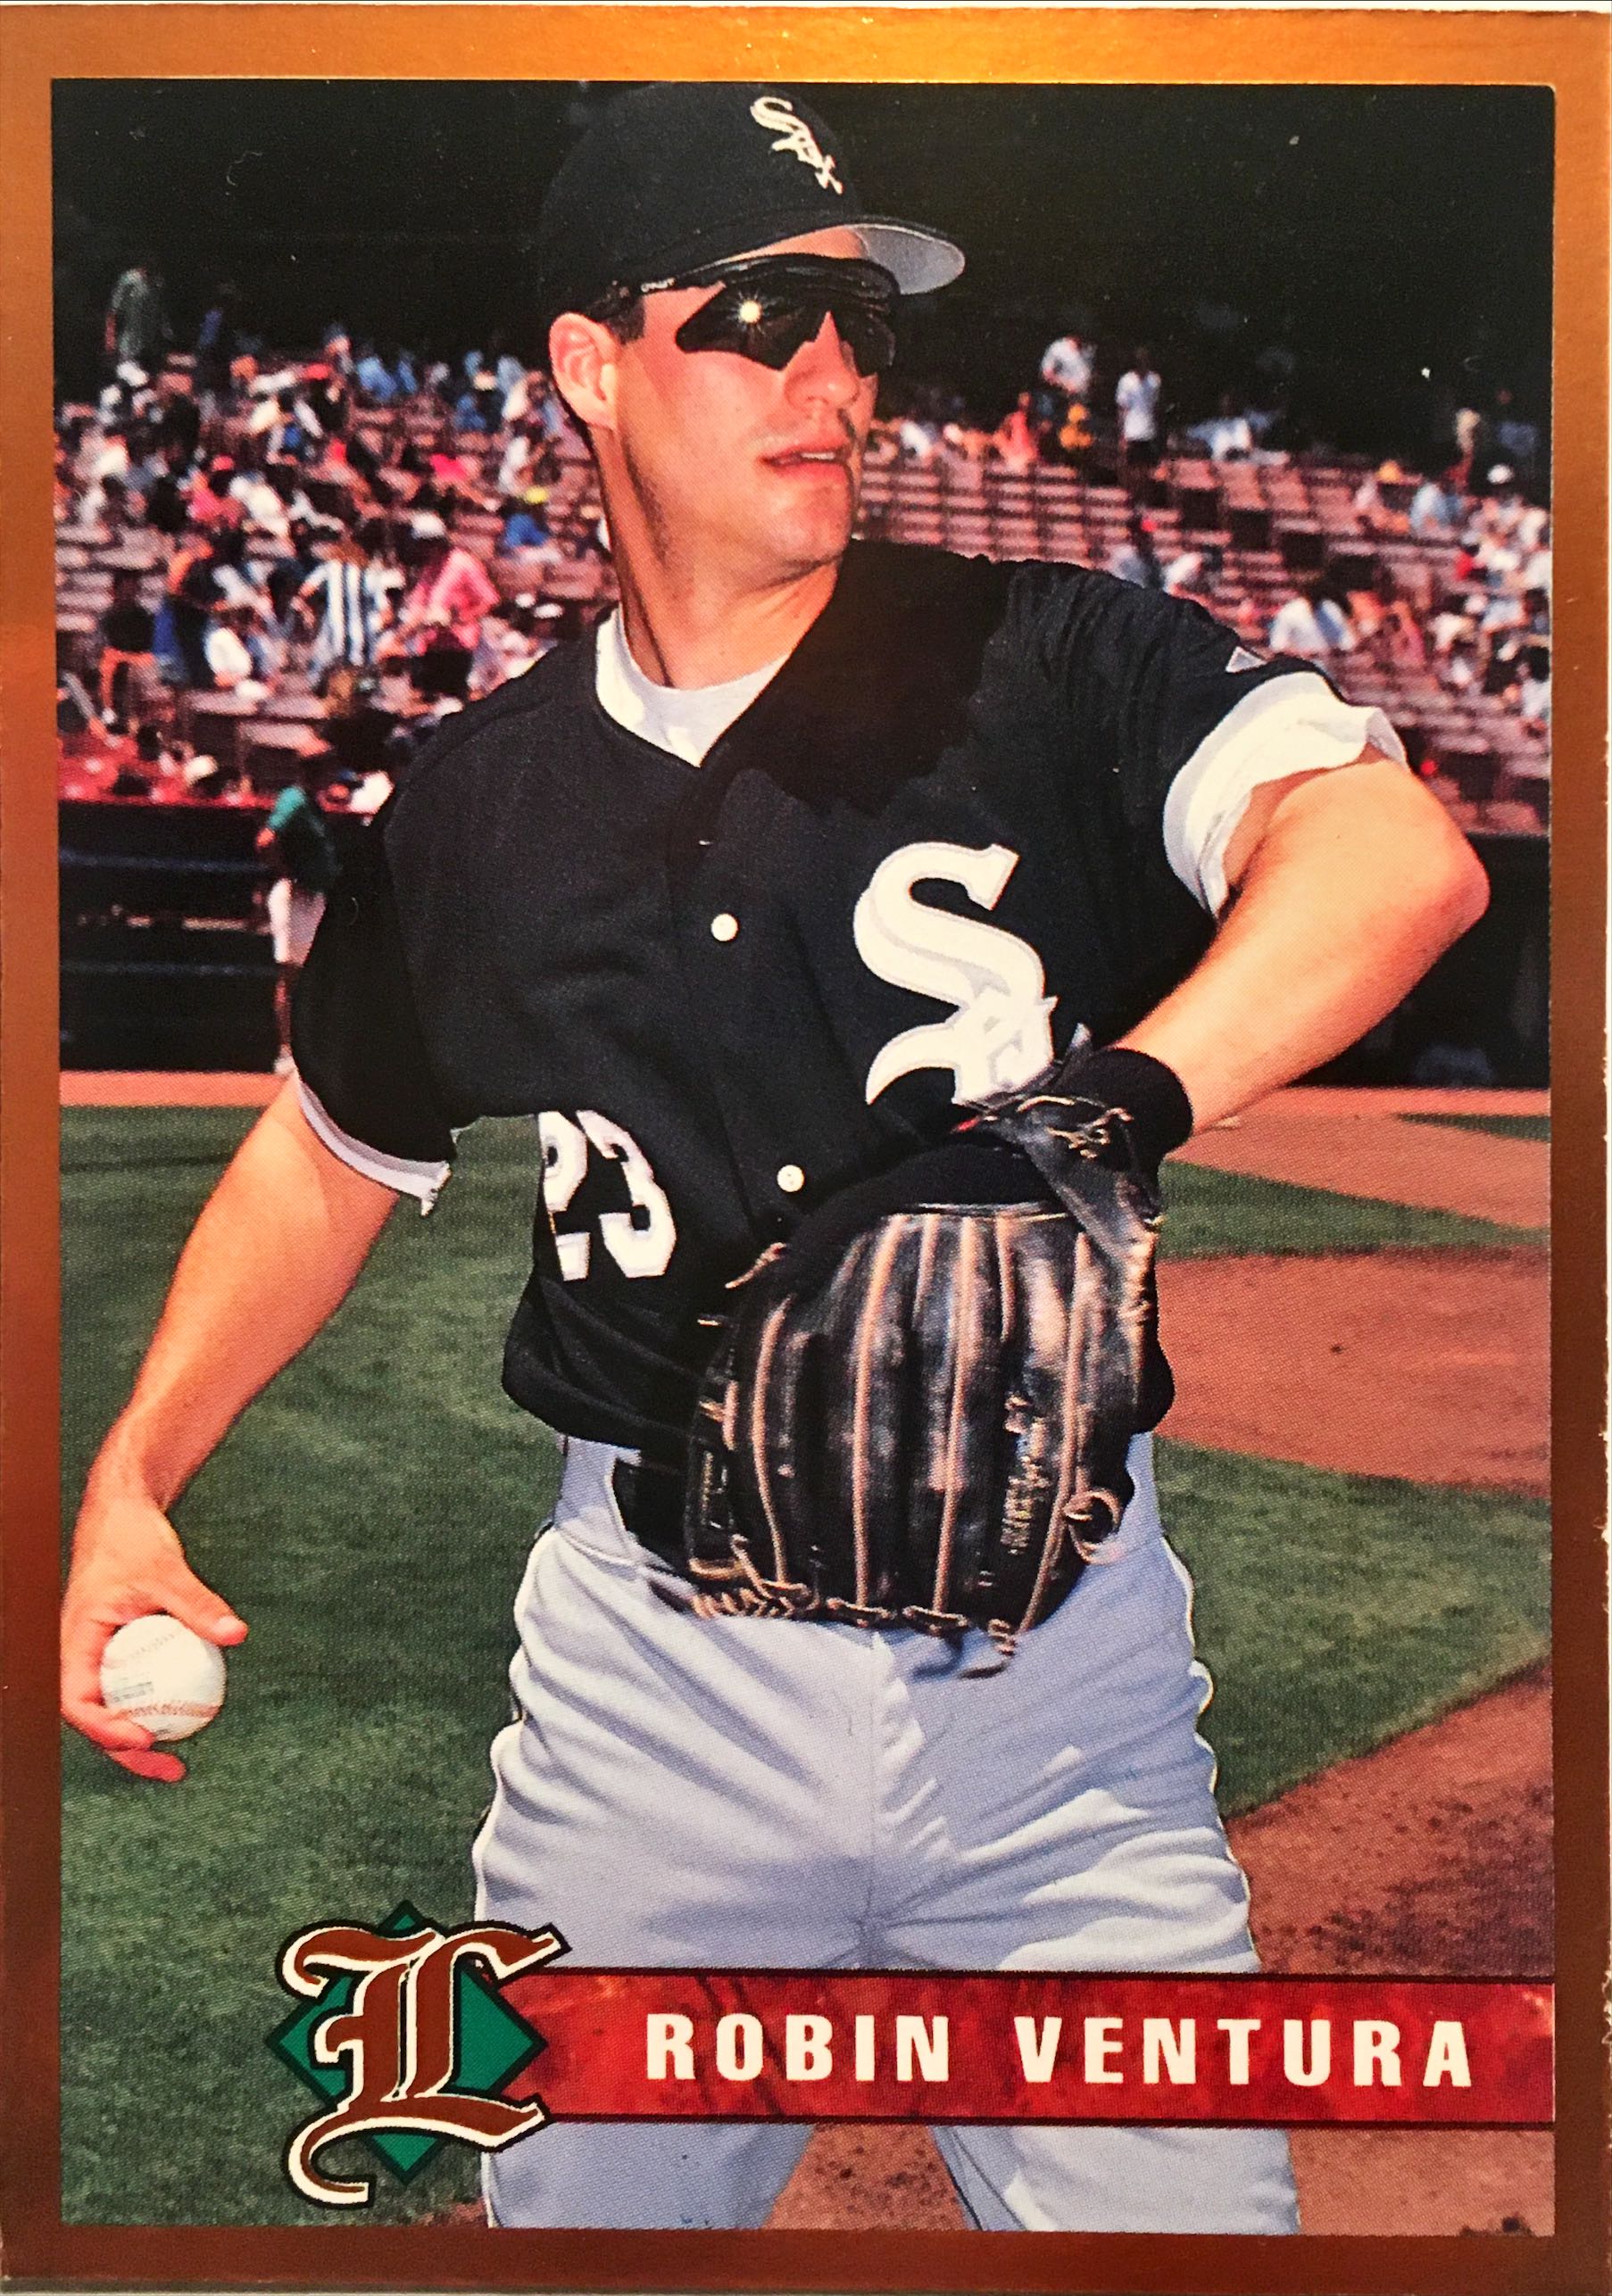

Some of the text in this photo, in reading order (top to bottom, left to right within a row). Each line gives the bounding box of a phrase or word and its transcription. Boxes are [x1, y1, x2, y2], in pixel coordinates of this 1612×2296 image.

[538, 1110, 677, 1281] 23
[646, 2012, 1472, 2088] ROBIN VENTURA
